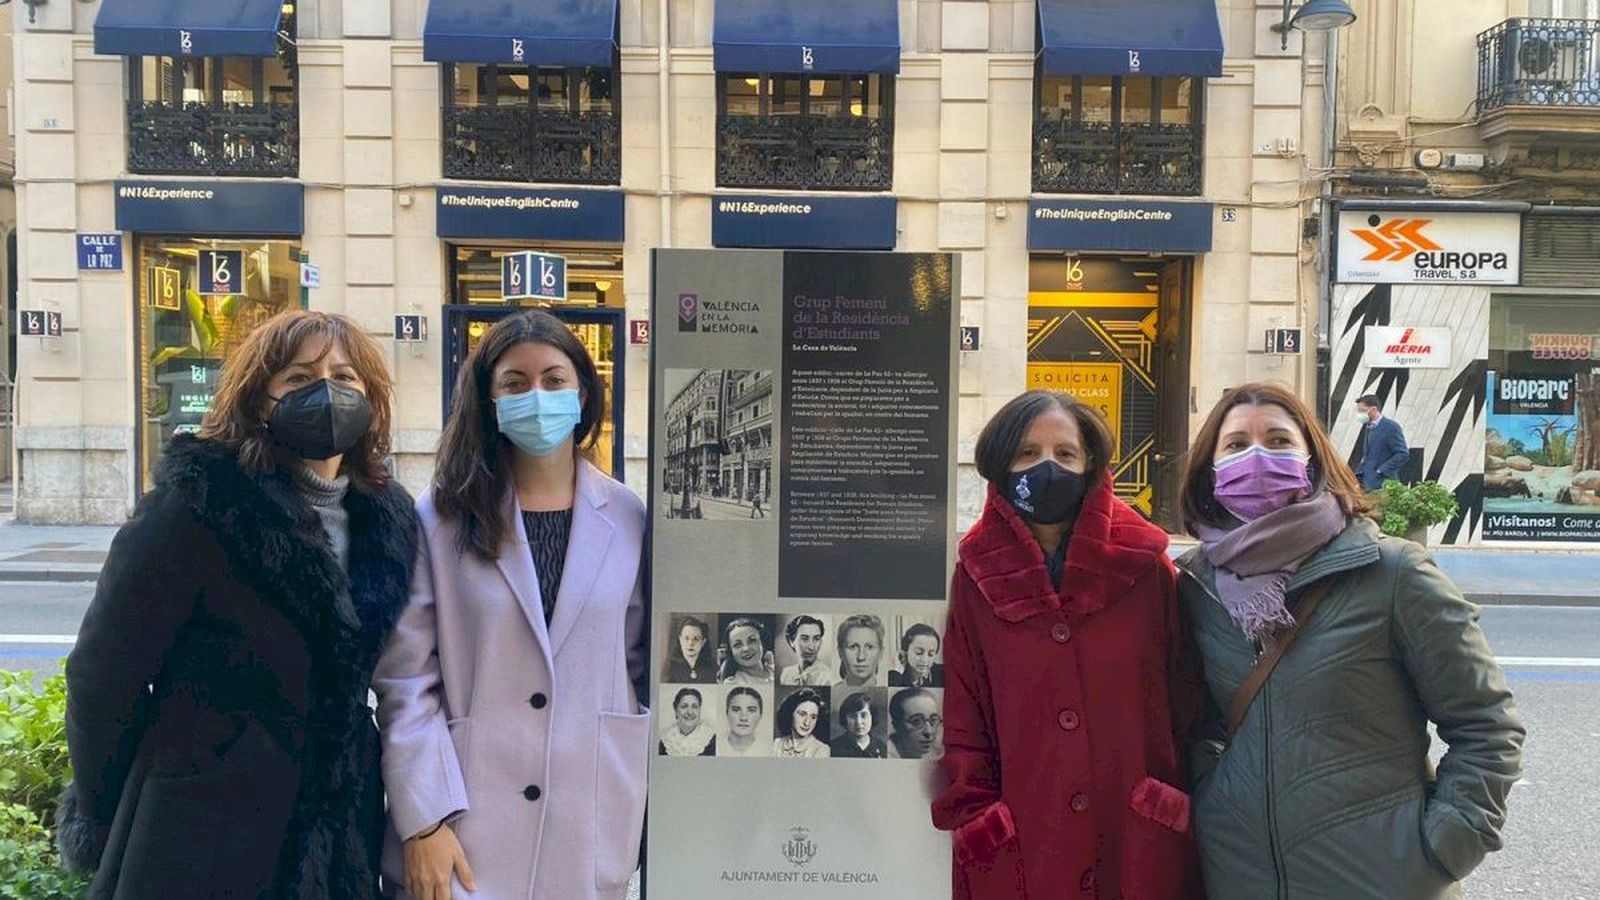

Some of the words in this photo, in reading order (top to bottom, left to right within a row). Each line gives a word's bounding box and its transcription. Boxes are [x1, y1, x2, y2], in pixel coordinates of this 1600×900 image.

[119, 187, 214, 202] #N16Experience
[441, 195, 579, 210] #TheUniqueEnglishCentre
[719, 200, 812, 216] #N16Experience
[1034, 208, 1172, 221] #TheUniqueEnglishCentre
[83, 236, 116, 246] CALLE
[87, 254, 97, 268] LA
[100, 254, 113, 268] PAZ
[209, 252, 231, 283] 16
[510, 257, 521, 287] 16
[539, 257, 556, 287] 16
[1067, 256, 1084, 282] 16
[794, 295, 831, 311] Grup
[702, 313, 714, 321] EN
[717, 313, 730, 321] LA
[793, 312, 813, 324] de
[816, 312, 829, 324] la
[793, 327, 881, 341] d'Estudiants
[1386, 345, 1431, 354] IBERIA
[1394, 356, 1422, 365] Agente
[1035, 373, 1109, 383] SOLICITA
[1080, 388, 1110, 398] CLASS
[1488, 514, 1556, 528] ¡Visítanos!
[1563, 517, 1593, 528] Come
[720, 871, 801, 883] AJUNTAMENT
[802, 872, 820, 883] DE
